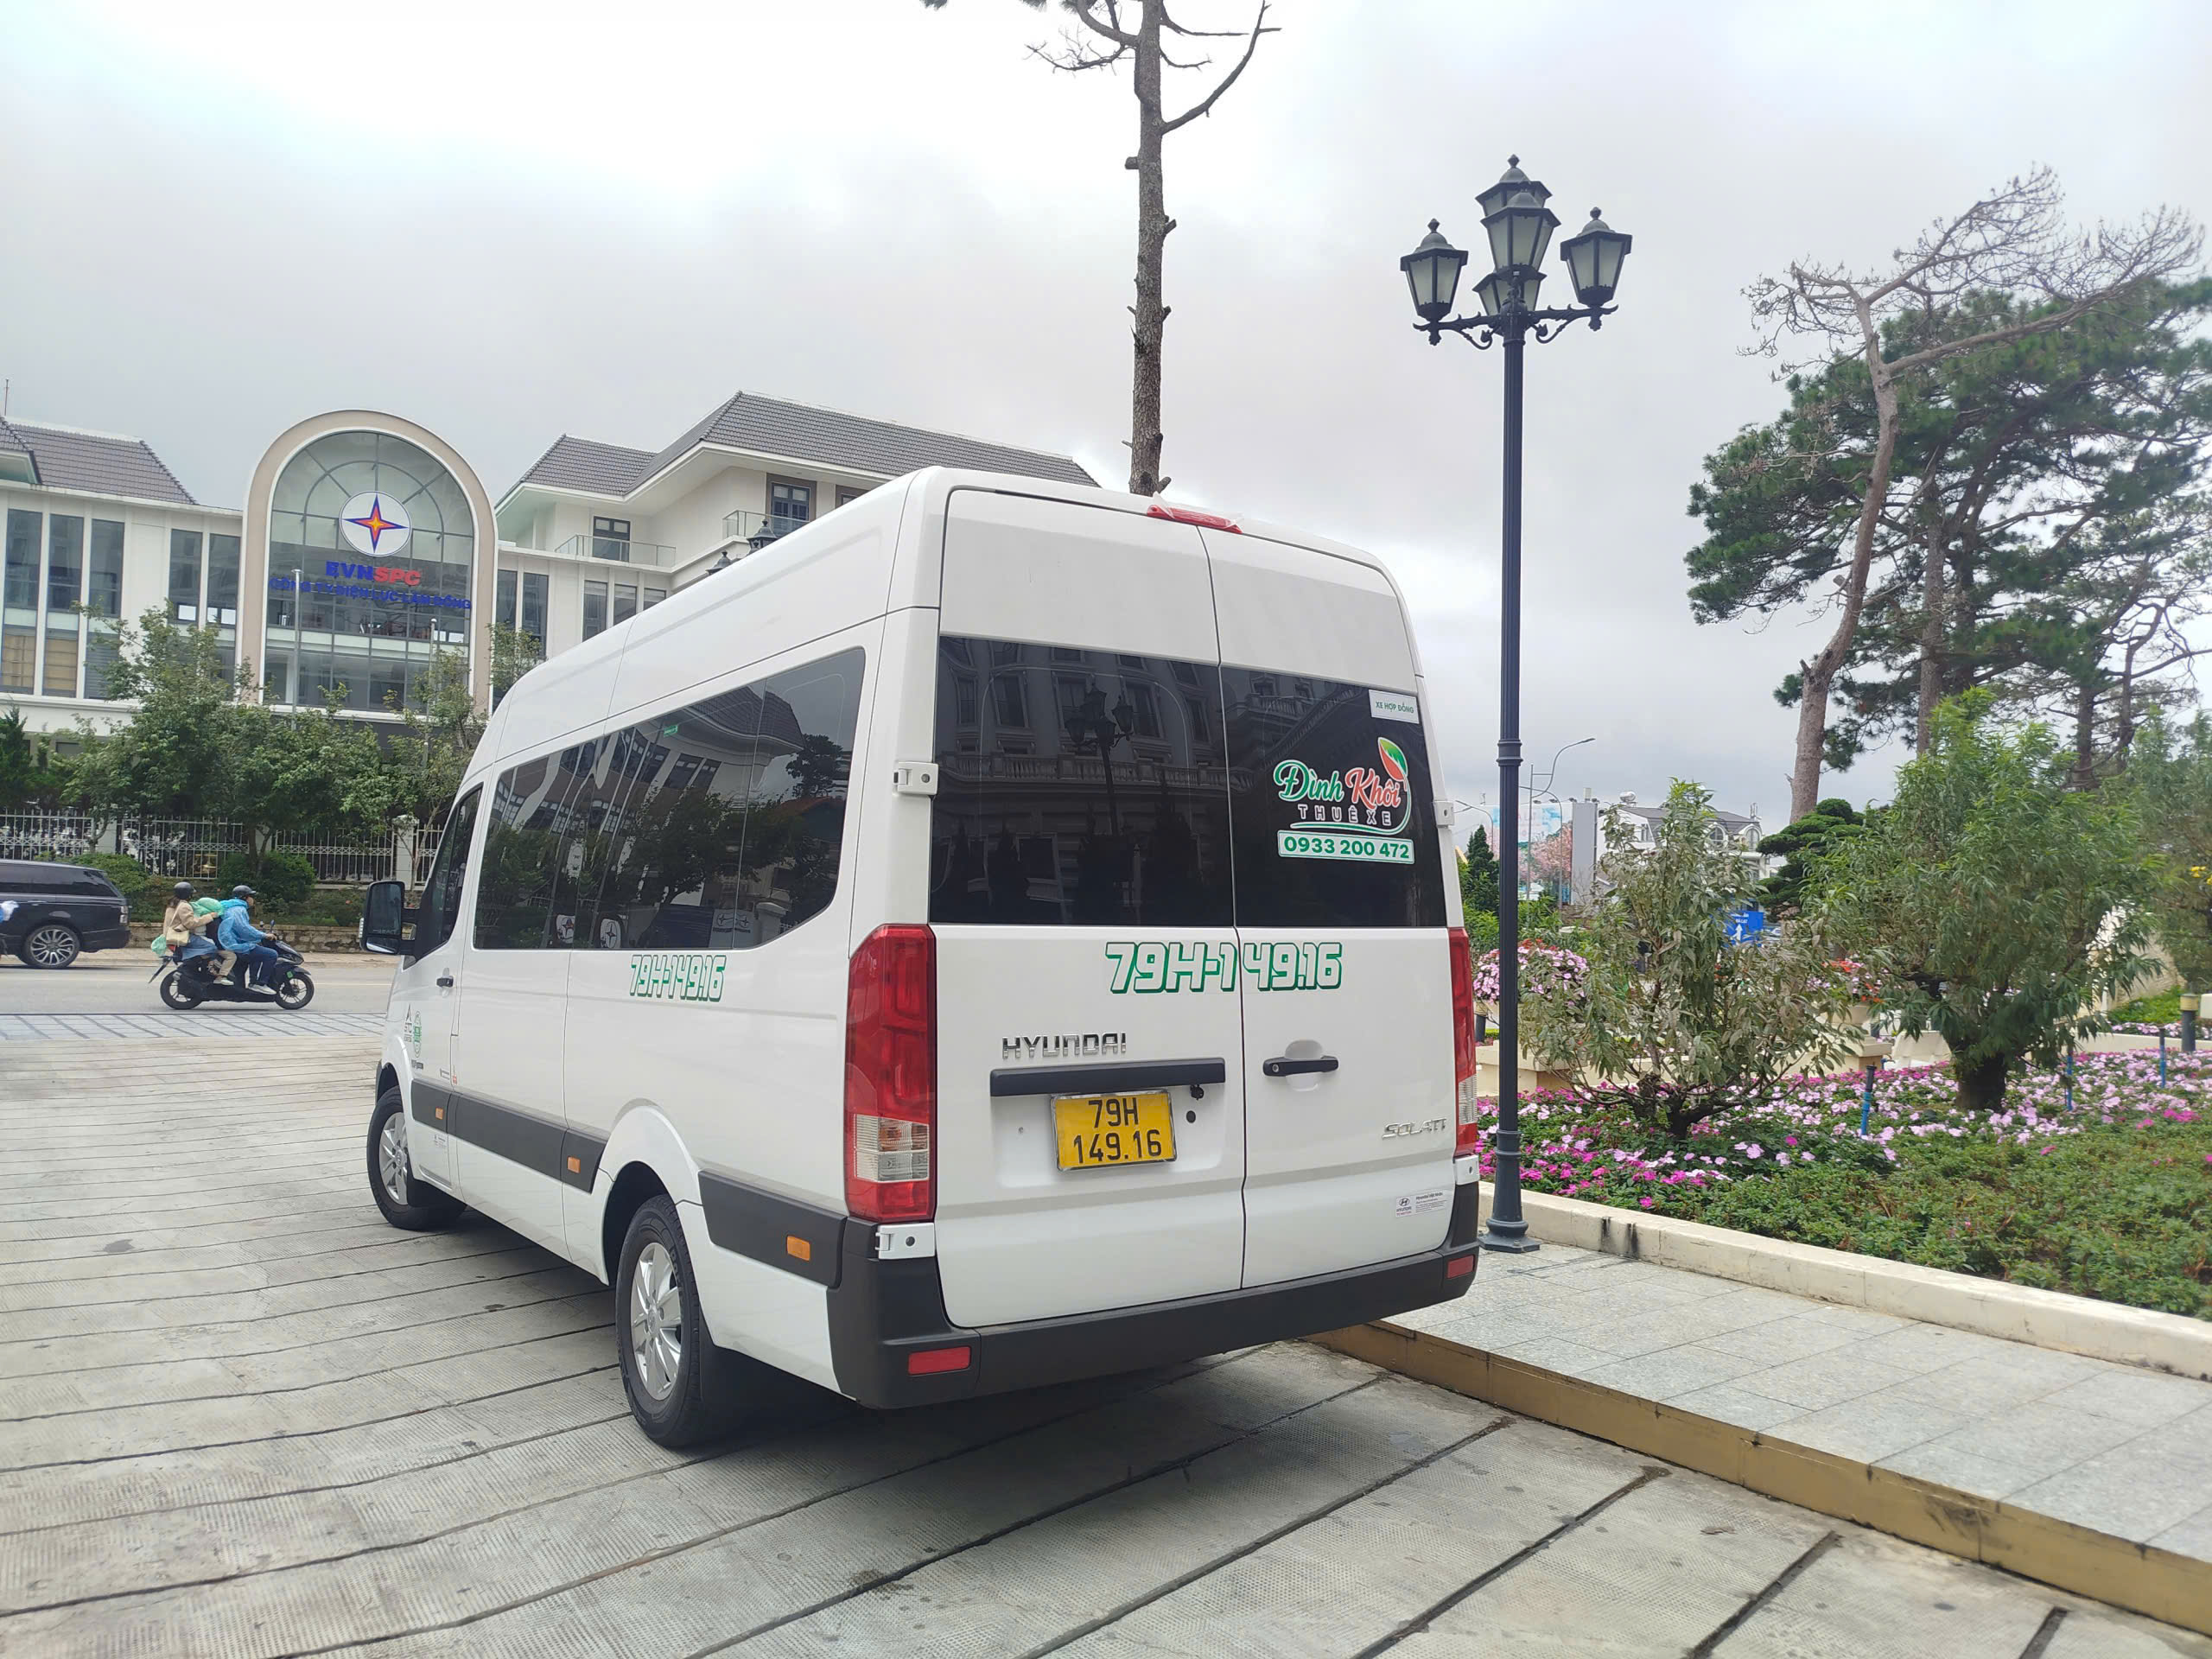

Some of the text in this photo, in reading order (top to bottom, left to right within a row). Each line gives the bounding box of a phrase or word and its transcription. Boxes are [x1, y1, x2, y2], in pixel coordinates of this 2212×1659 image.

[325, 560, 422, 586] EVNSPC
[315, 582, 335, 594] TY
[1375, 701, 1383, 709] XE
[1397, 702, 1414, 714] ĐỒNG
[1274, 760, 1402, 810] Đình Khôi
[1283, 836, 1409, 859] 0933 200 472
[630, 954, 727, 1002] 79H-149.16
[1002, 1033, 1126, 1059] HYUNDAI
[1088, 1097, 1139, 1128] 79H
[1074, 1130, 1162, 1164] 149.16
